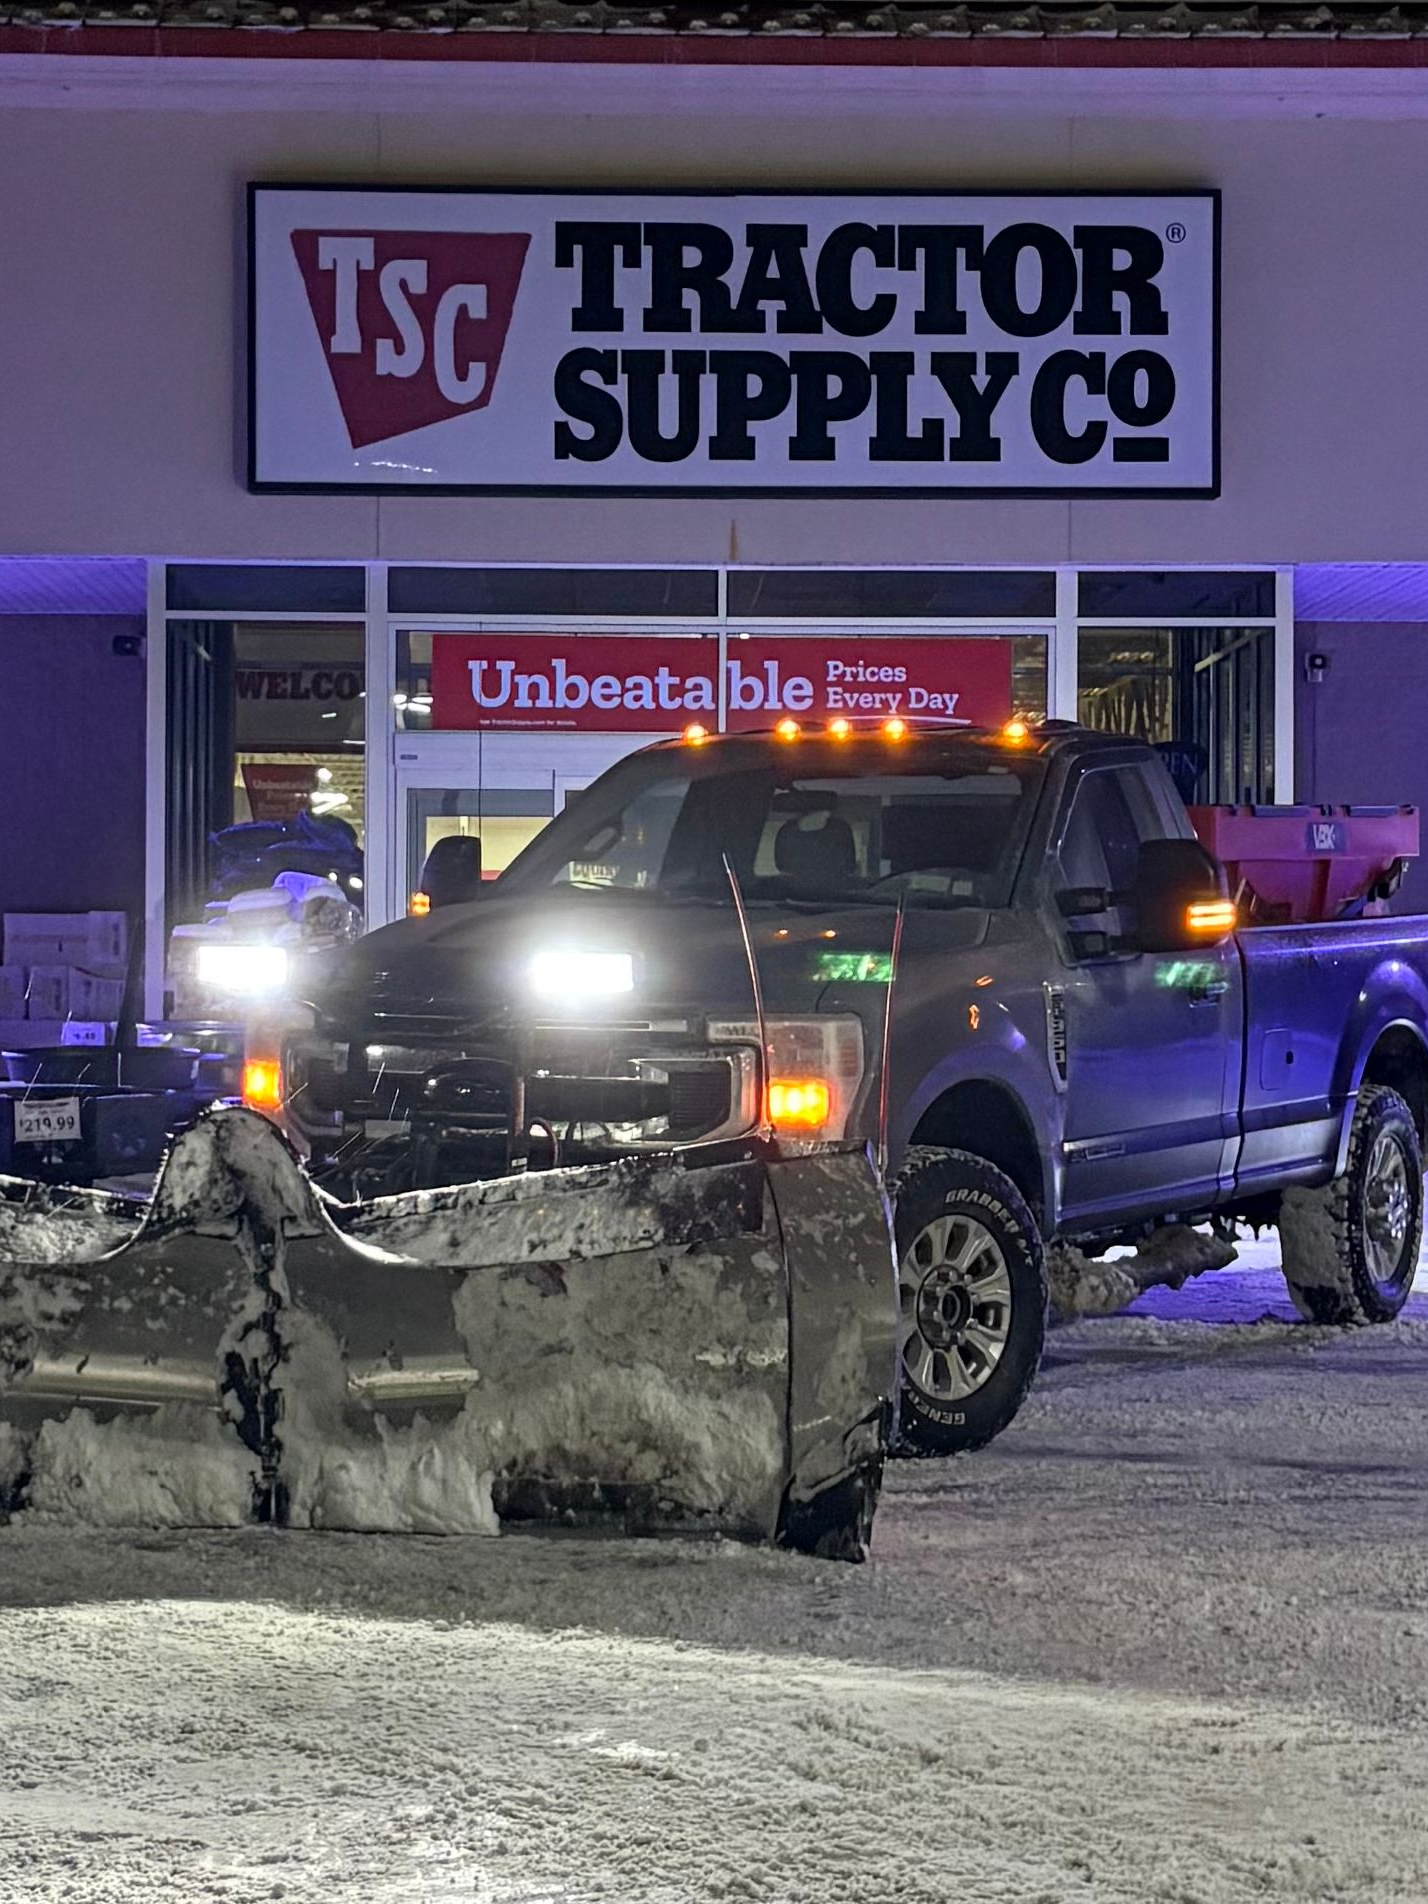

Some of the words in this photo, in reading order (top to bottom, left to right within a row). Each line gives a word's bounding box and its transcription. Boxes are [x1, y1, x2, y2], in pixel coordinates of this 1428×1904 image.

[555, 221, 1169, 337] TRACTOR
[318, 236, 487, 405] TSC
[554, 348, 1019, 463] SUPPLY
[235, 670, 365, 701] WELCO
[467, 659, 815, 711] Unbeatable
[826, 660, 907, 683] Prices
[826, 687, 902, 715] Every
[909, 687, 959, 715] Day
